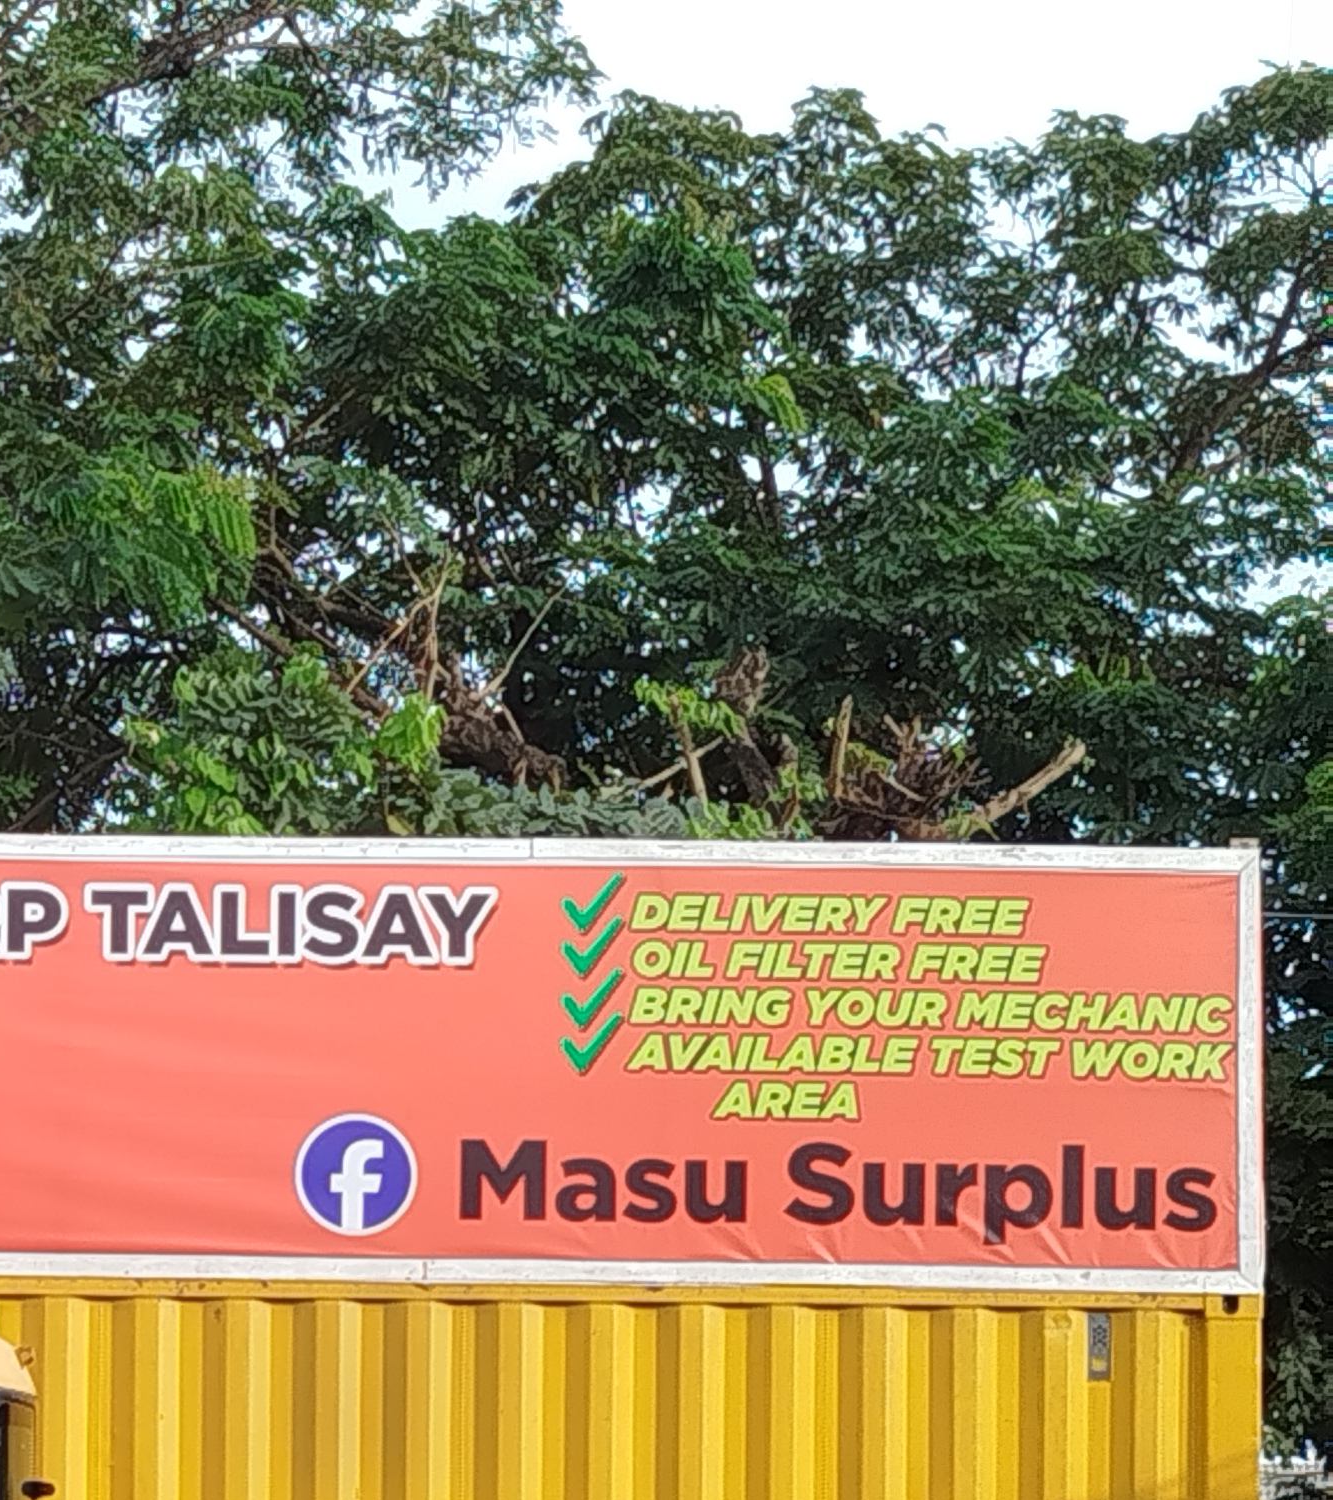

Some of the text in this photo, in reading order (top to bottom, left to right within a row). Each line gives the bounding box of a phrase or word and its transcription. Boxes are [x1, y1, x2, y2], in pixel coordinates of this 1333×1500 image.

[85, 884, 497, 967] TALISAY
[630, 895, 1030, 937] DELIVERY FREE
[632, 941, 1046, 984] OIL FILTER FREE
[629, 988, 1232, 1034] BRING YOUR MECHANIC
[629, 1033, 1232, 1081] AVAILABLE TEST WORK
[713, 1081, 860, 1120] AREA
[459, 1139, 746, 1224] Masu
[786, 1141, 1217, 1246] Surplus
